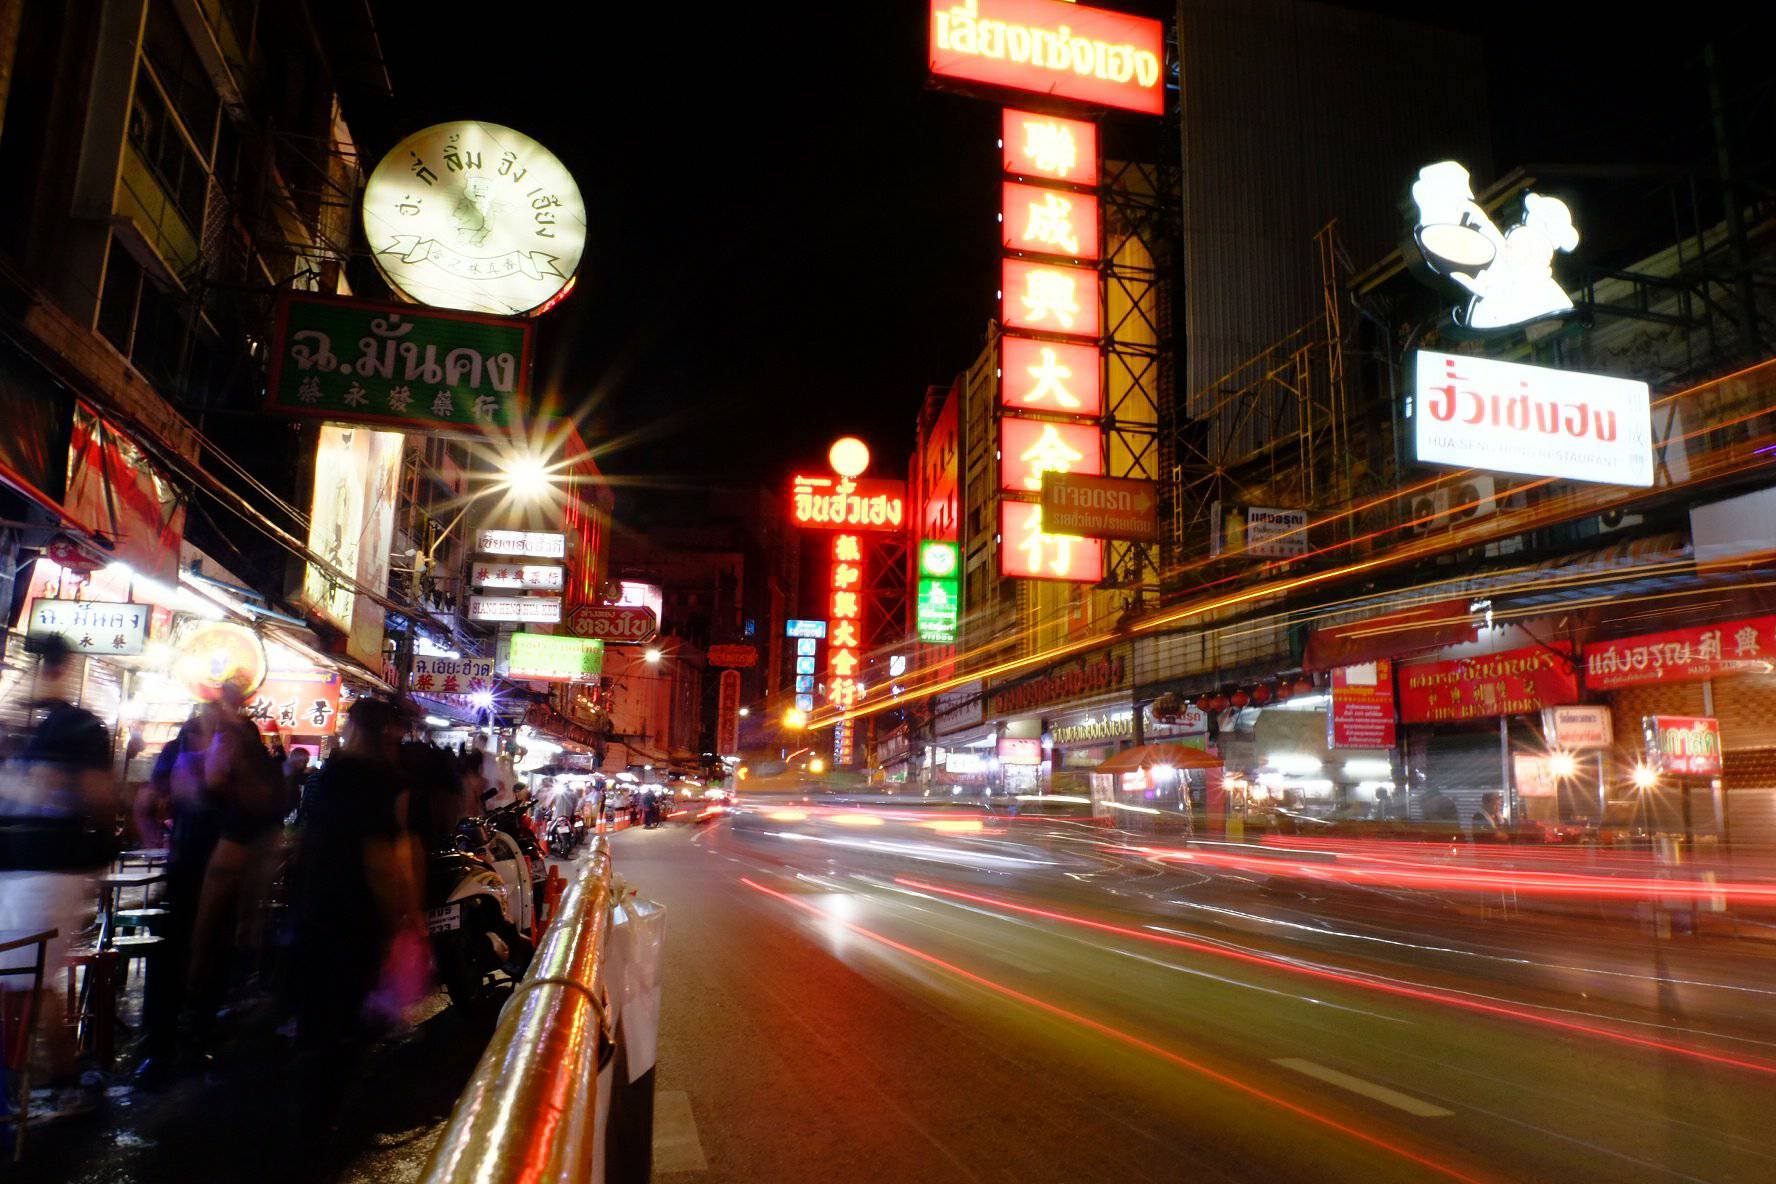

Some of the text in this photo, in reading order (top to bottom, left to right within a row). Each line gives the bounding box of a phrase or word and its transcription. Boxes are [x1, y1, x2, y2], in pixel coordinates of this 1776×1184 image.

[291, 314, 517, 393] ฉ.มั่นคง
[1588, 640, 1692, 678] แสงอรุณ
